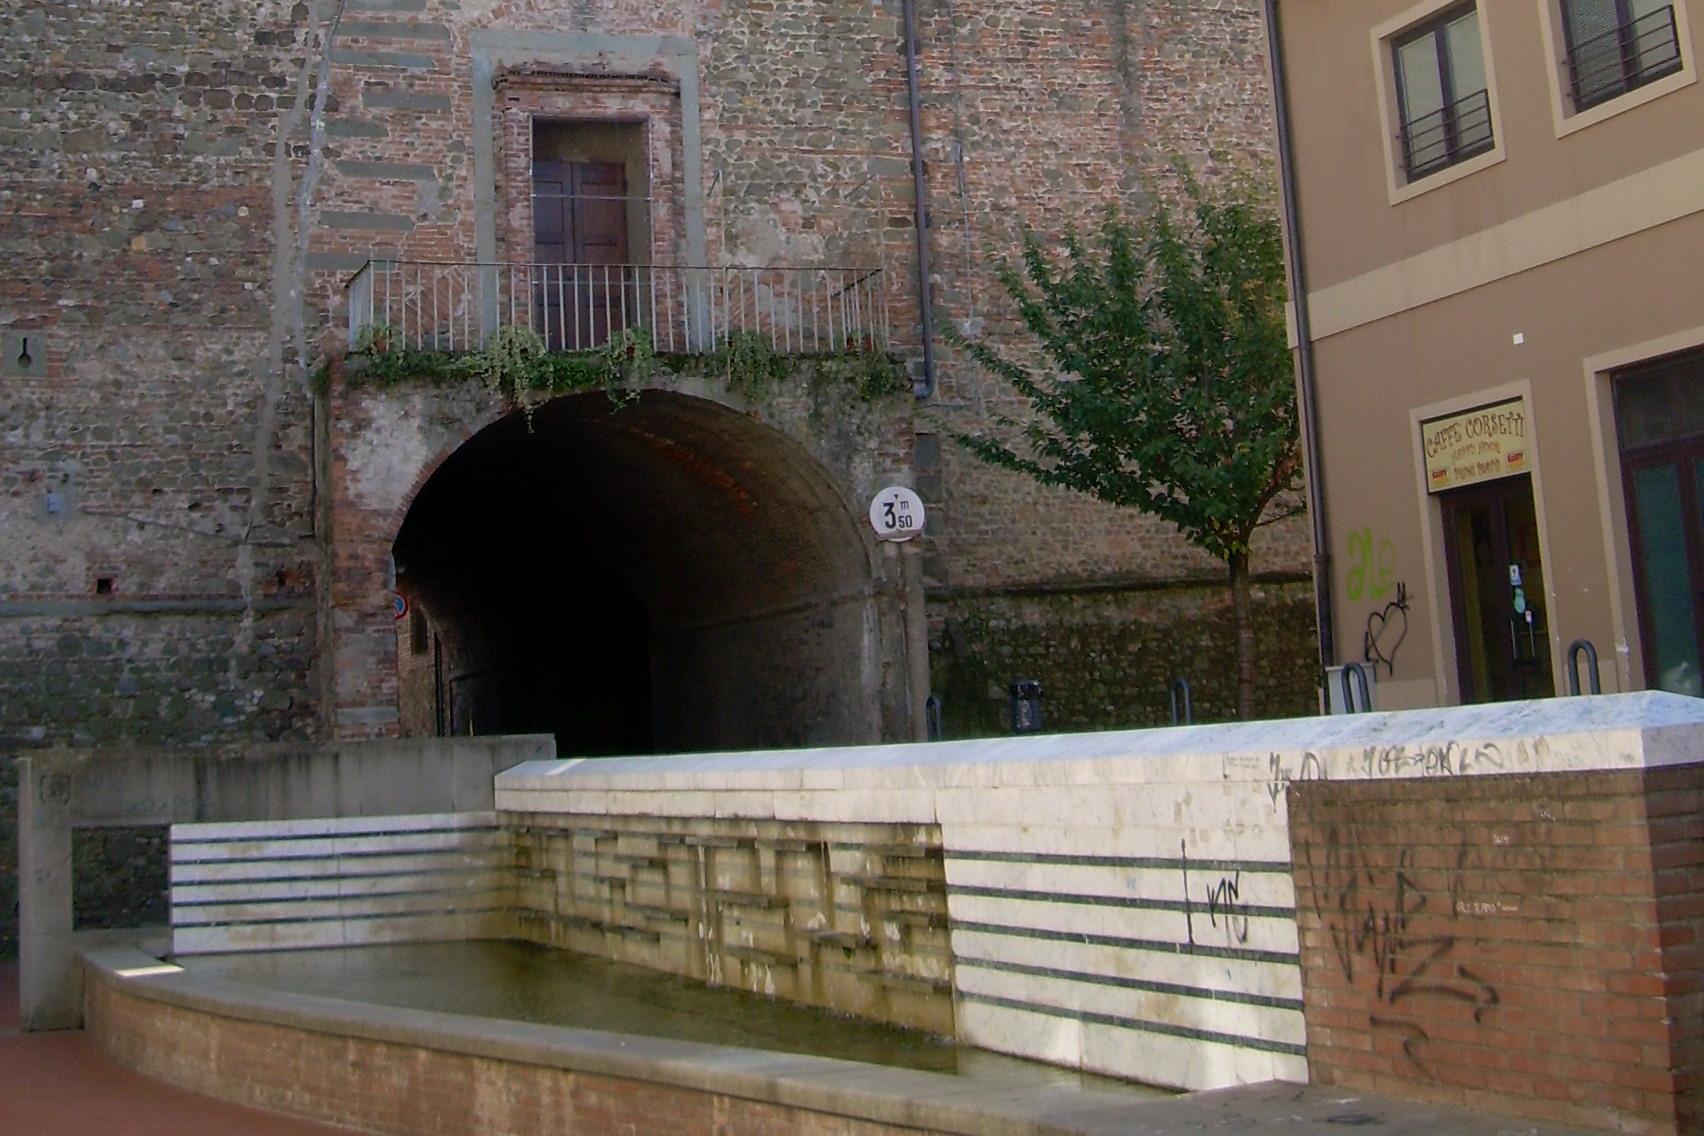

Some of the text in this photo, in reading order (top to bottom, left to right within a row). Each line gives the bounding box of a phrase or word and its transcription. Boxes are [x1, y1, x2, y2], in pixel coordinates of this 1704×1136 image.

[1465, 412, 1524, 438] CORSETTI
[883, 501, 909, 528] 3 m
[898, 515, 912, 528] 50
